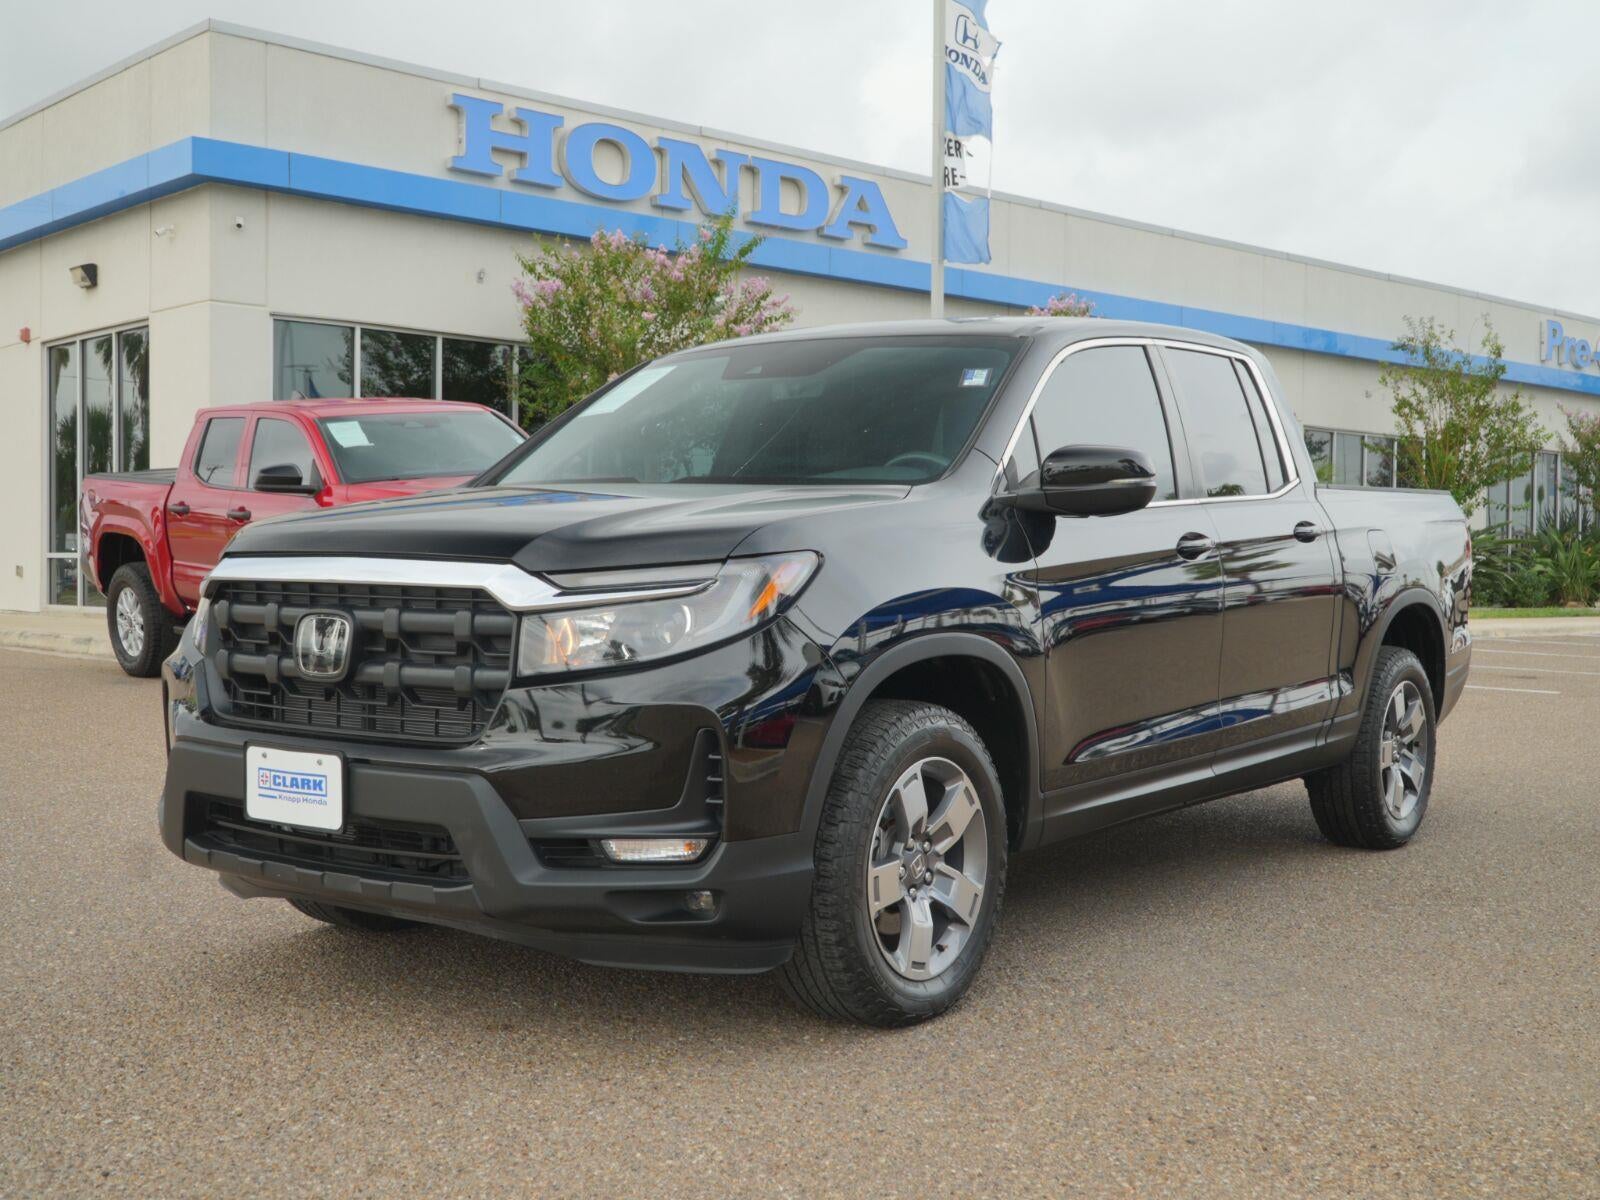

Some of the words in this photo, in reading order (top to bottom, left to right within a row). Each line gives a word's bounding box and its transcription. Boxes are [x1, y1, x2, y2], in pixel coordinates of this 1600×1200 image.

[447, 93, 907, 249] HONDA
[272, 774, 325, 791] CLARK
[302, 797, 328, 806] Honda
